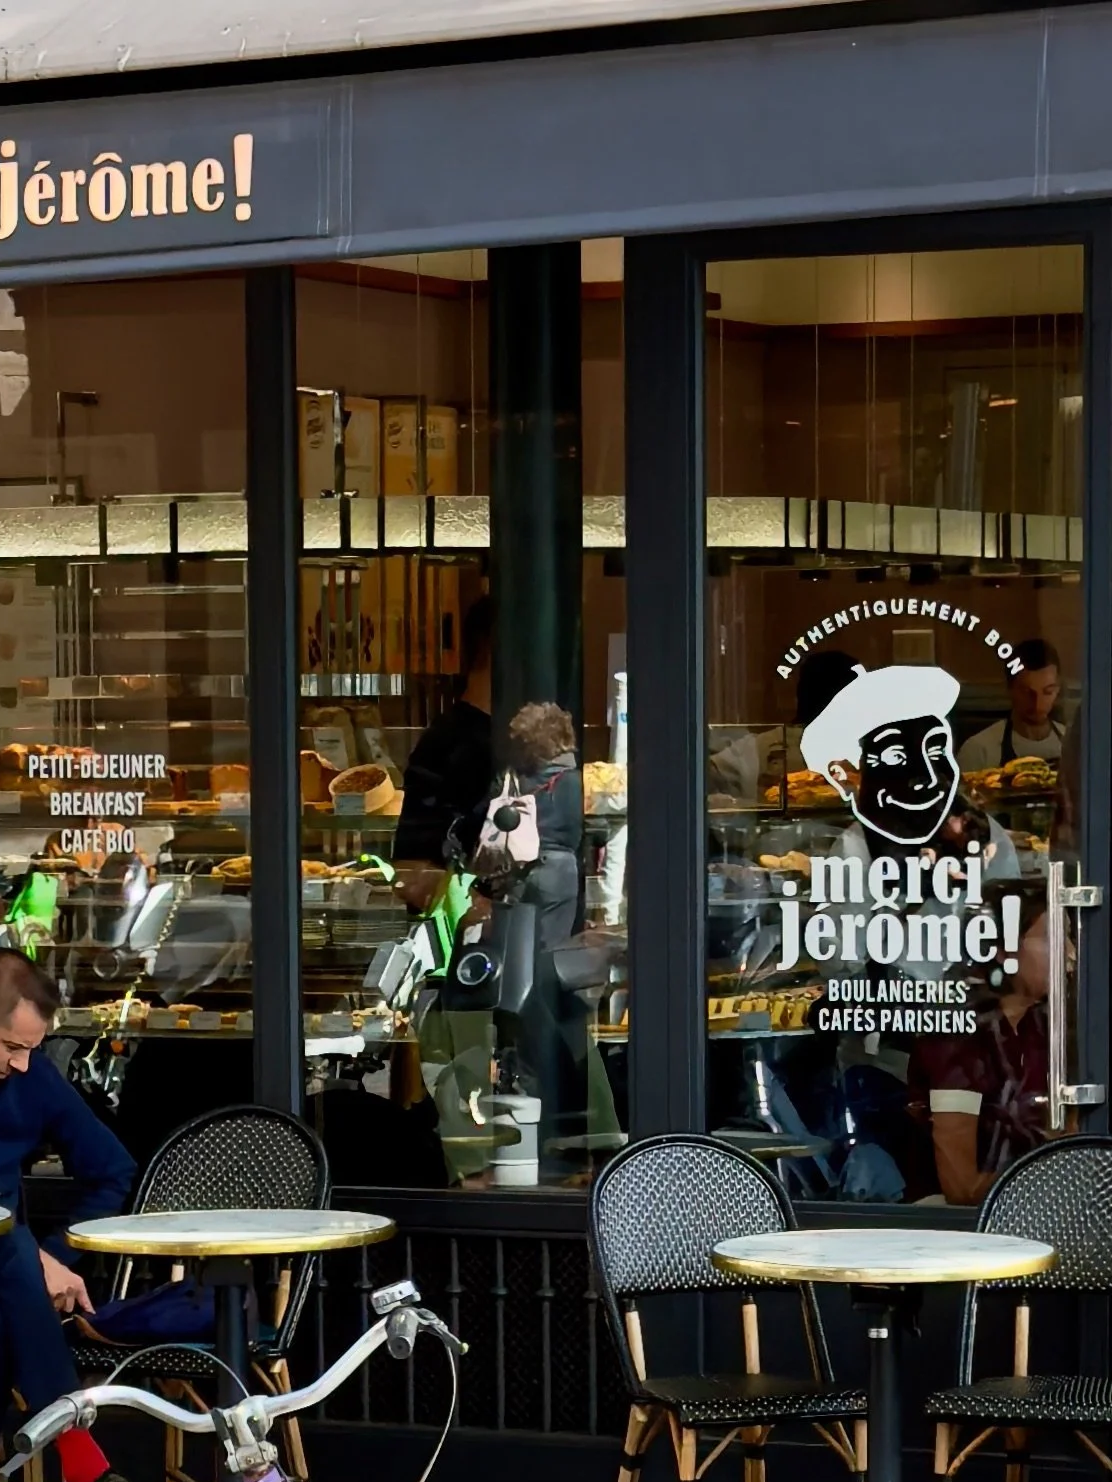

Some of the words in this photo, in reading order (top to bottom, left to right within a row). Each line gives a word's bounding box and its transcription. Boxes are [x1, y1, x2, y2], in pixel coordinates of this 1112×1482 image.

[984, 629, 1025, 676] BON
[50, 792, 146, 816] BREAKFAST
[106, 829, 135, 854] BIO
[809, 840, 984, 905] merci
[776, 880, 1021, 975] jérôme!
[828, 978, 968, 1004] BOULANGERIES
[818, 1005, 876, 1032] CAFÉS
[880, 1008, 977, 1034] PARISIENS
